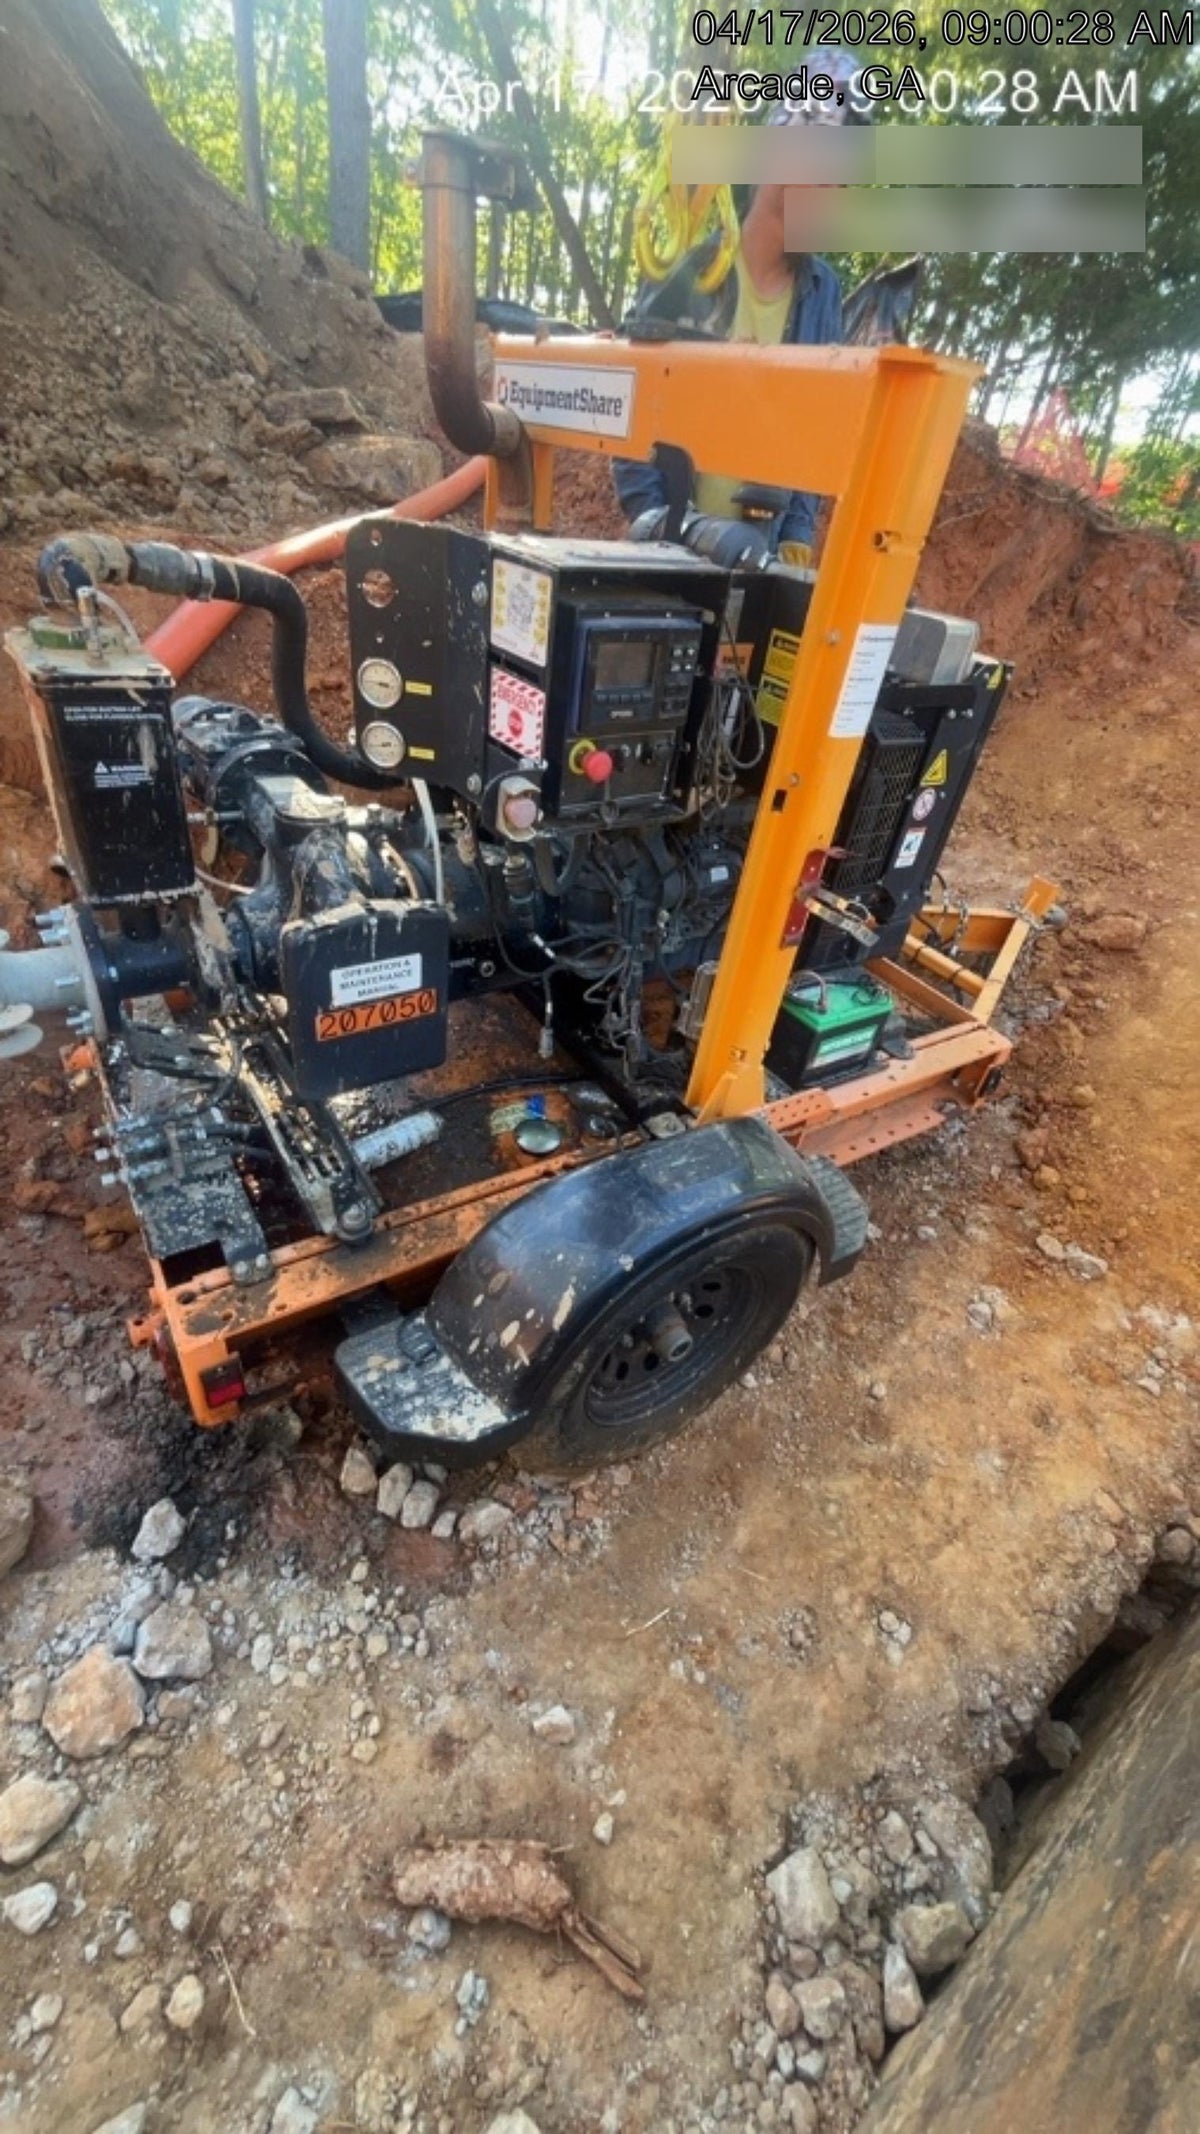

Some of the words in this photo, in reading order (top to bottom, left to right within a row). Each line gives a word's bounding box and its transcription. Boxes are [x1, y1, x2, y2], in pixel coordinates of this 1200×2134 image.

[510, 380, 623, 417] EquipmentShare
[340, 968, 412, 990] MAINTENANCE
[341, 960, 402, 979] OPERATION
[320, 990, 434, 1038] 207050
